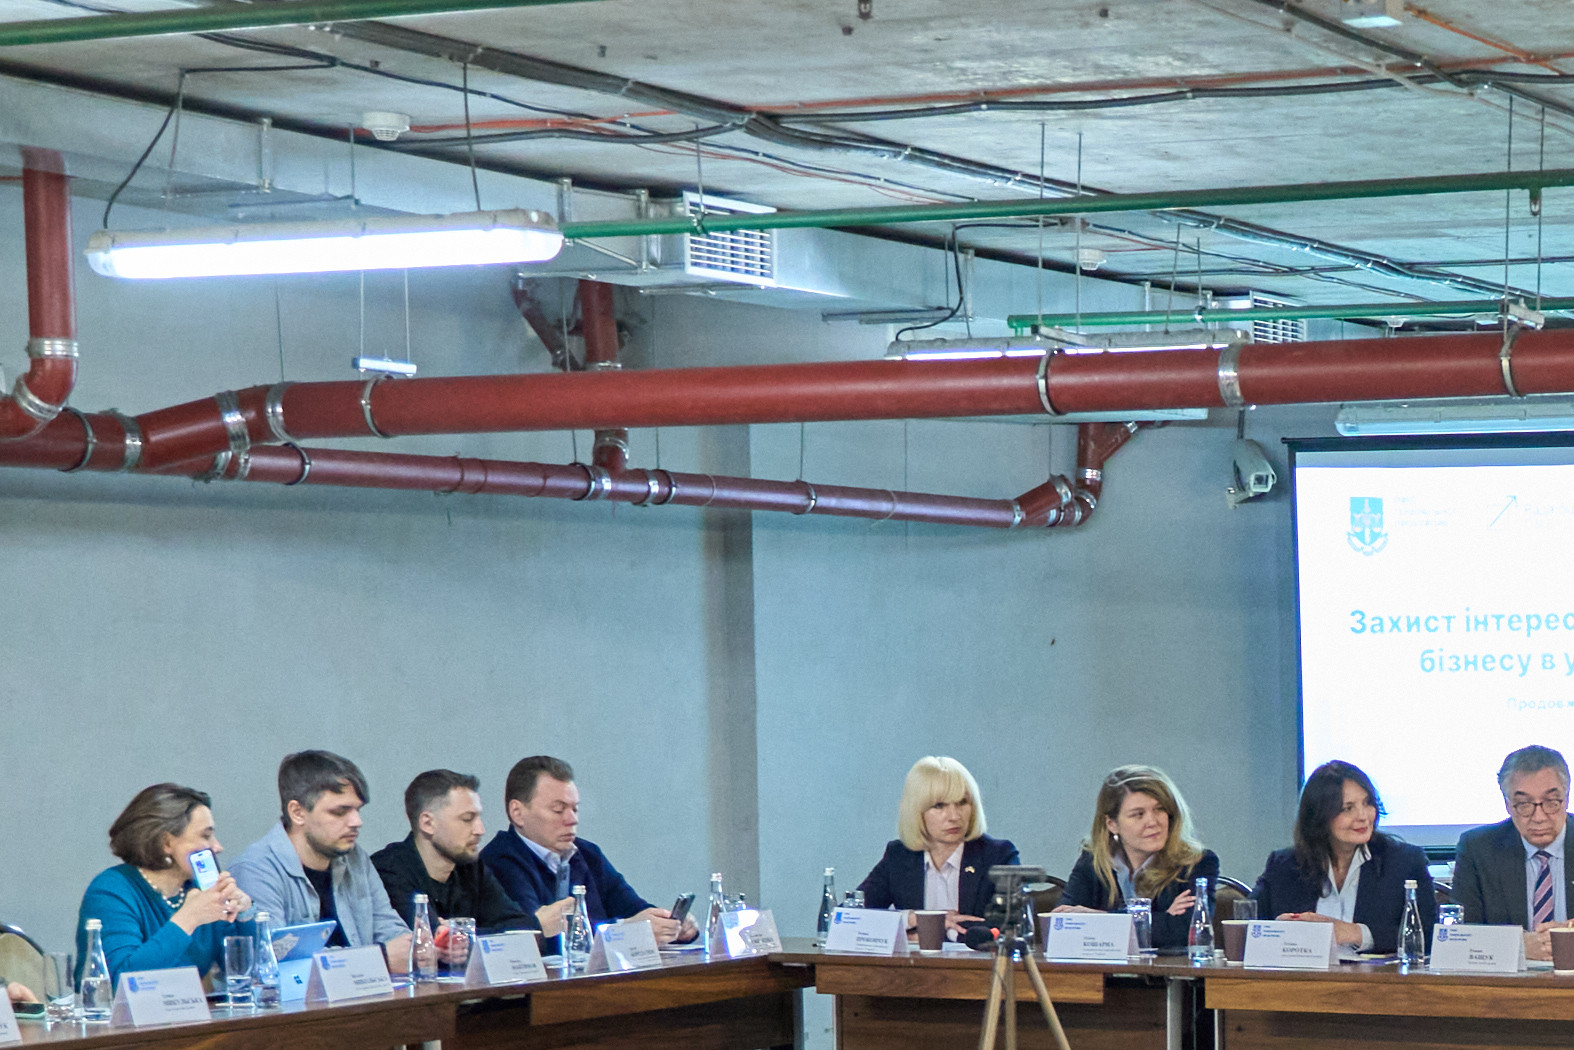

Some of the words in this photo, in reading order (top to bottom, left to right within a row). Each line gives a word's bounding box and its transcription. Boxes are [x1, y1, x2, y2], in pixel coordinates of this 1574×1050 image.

[1350, 609, 1457, 634] Захист
[1419, 648, 1532, 678] бізнесу
[1541, 653, 1556, 670] в
